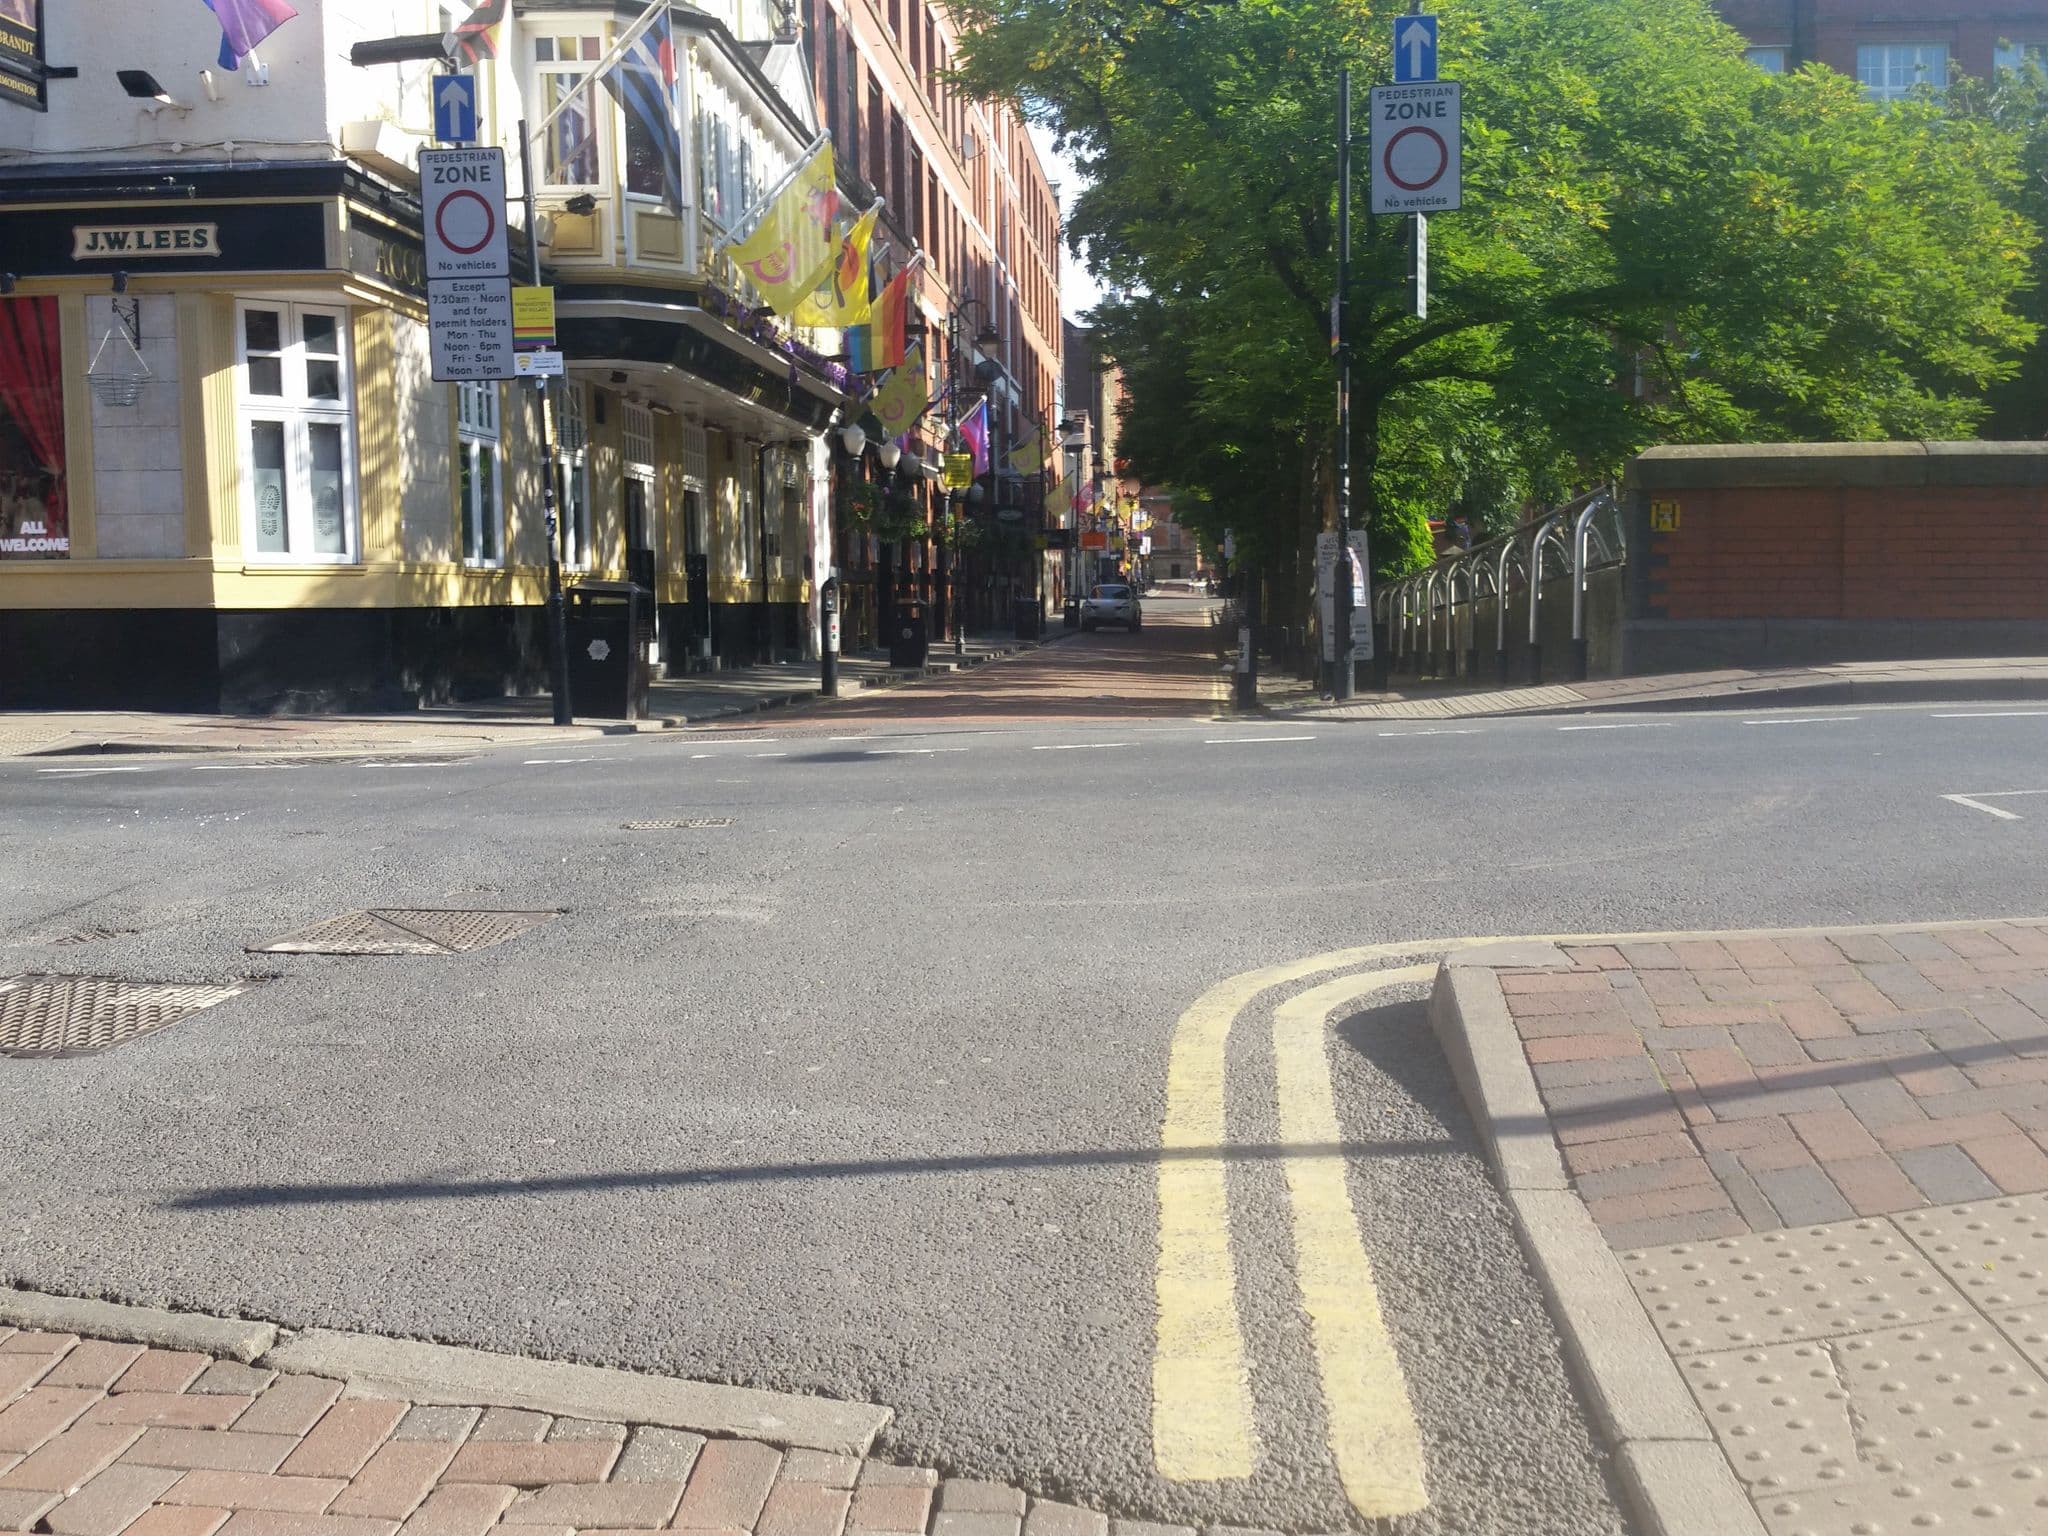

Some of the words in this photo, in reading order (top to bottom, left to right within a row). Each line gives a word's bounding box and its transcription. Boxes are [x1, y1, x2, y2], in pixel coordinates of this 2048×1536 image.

[1378, 87, 1454, 101] PEDESTRIAN
[1385, 100, 1447, 121] ZONE
[426, 152, 497, 164] PEDESTRIAN
[433, 165, 492, 185] ZONE
[1385, 198, 1400, 208] No
[1404, 195, 1448, 207] vehicles
[438, 261, 453, 271] No
[456, 260, 497, 271] vehicles
[451, 282, 486, 293] Except
[432, 294, 471, 305] 7.30am
[480, 293, 507, 303] Noon
[452, 306, 471, 316] and
[473, 305, 488, 316] for
[435, 319, 468, 329] permit
[470, 318, 507, 328] holders
[447, 331, 469, 340] Mon
[478, 329, 497, 339] Thu
[444, 342, 470, 352] Noon
[479, 341, 502, 352] 6pm
[452, 353, 465, 363] Fri
[475, 353, 495, 363] Sun
[446, 366, 473, 376] Noon
[482, 365, 502, 375] 1pm
[20, 521, 47, 534] ALL
[0, 538, 69, 552] WELCOME
